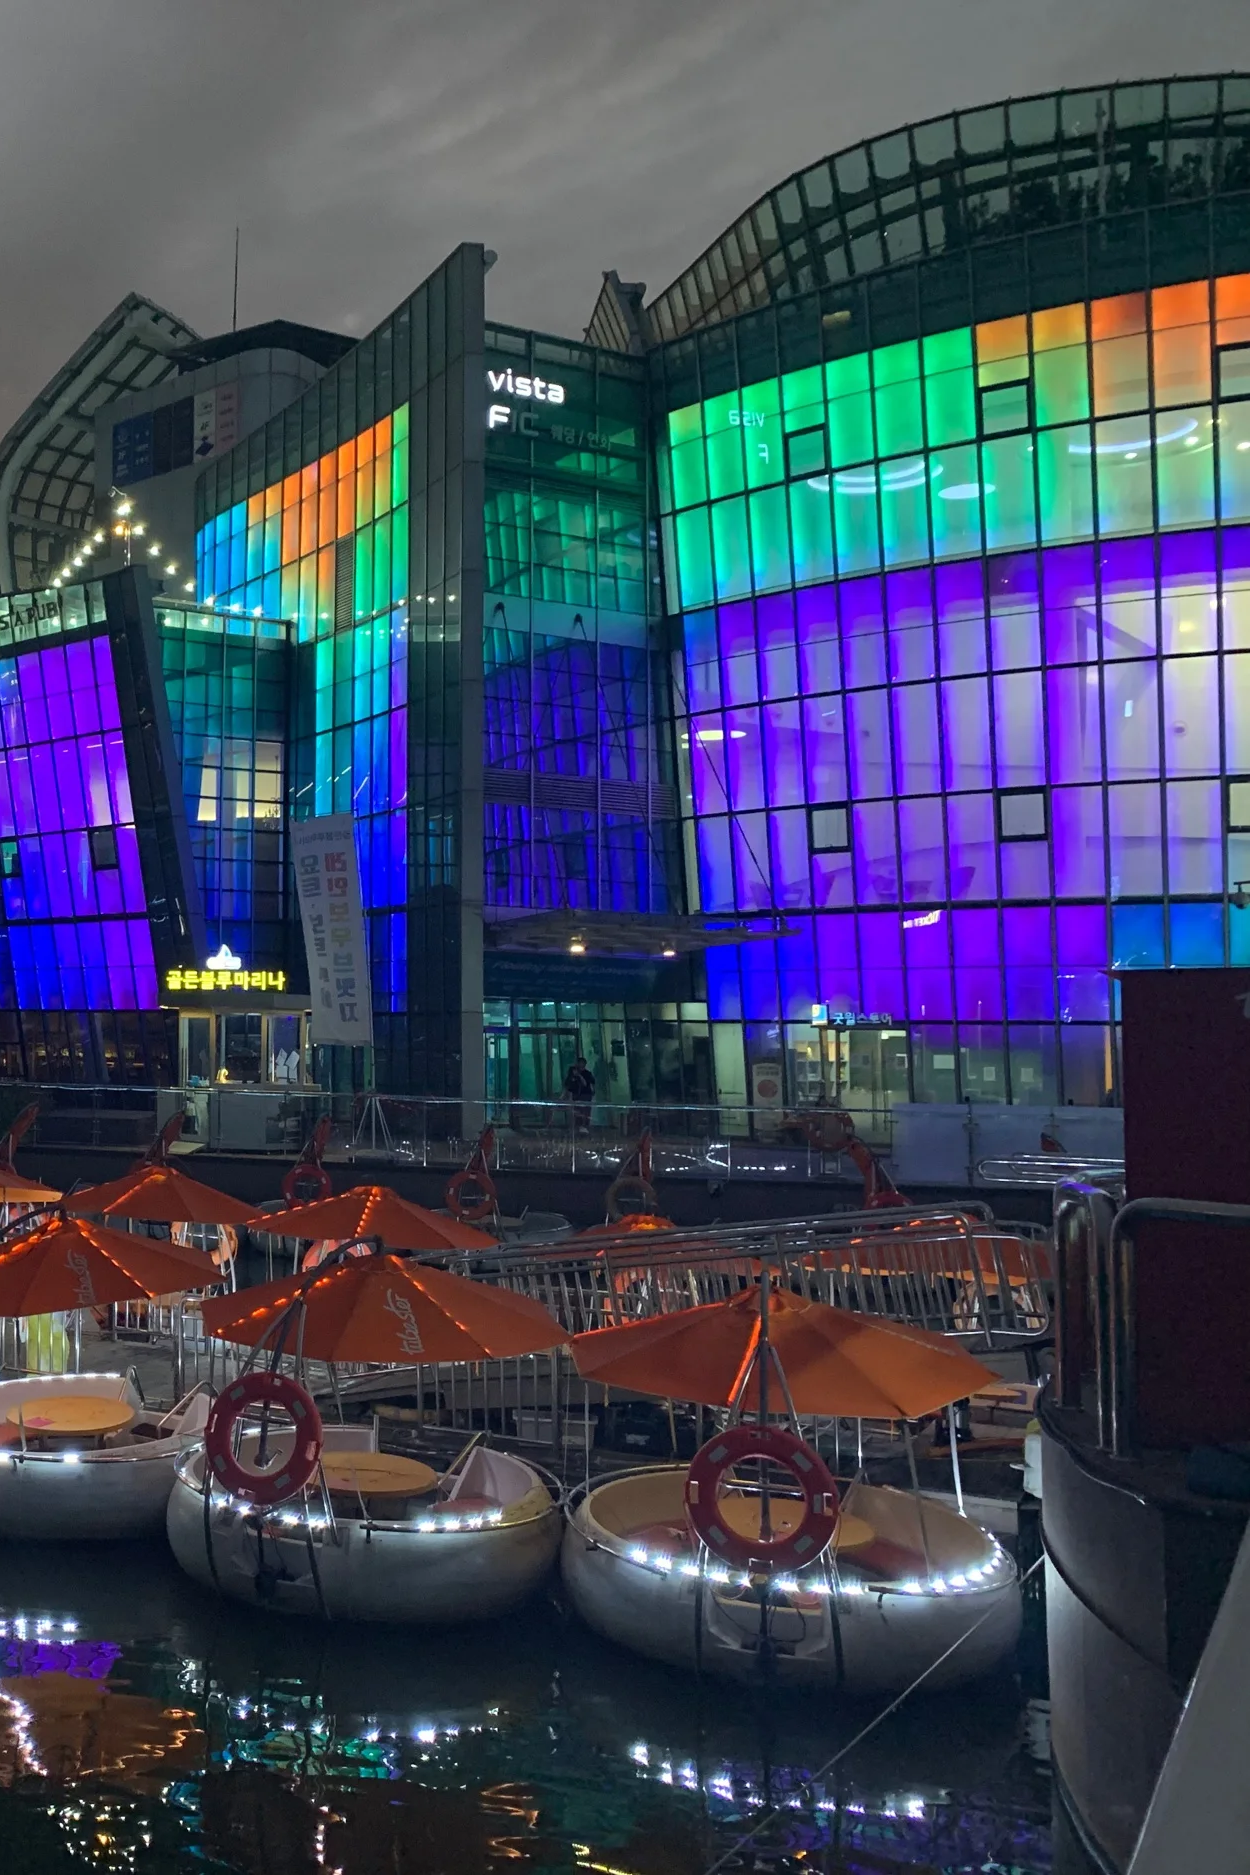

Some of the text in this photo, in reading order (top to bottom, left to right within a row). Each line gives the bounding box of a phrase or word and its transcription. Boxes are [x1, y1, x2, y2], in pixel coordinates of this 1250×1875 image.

[487, 368, 565, 404] vista
[166, 970, 286, 991] 골든블루마리나
[833, 1011, 893, 1026] 굿윌스토어
